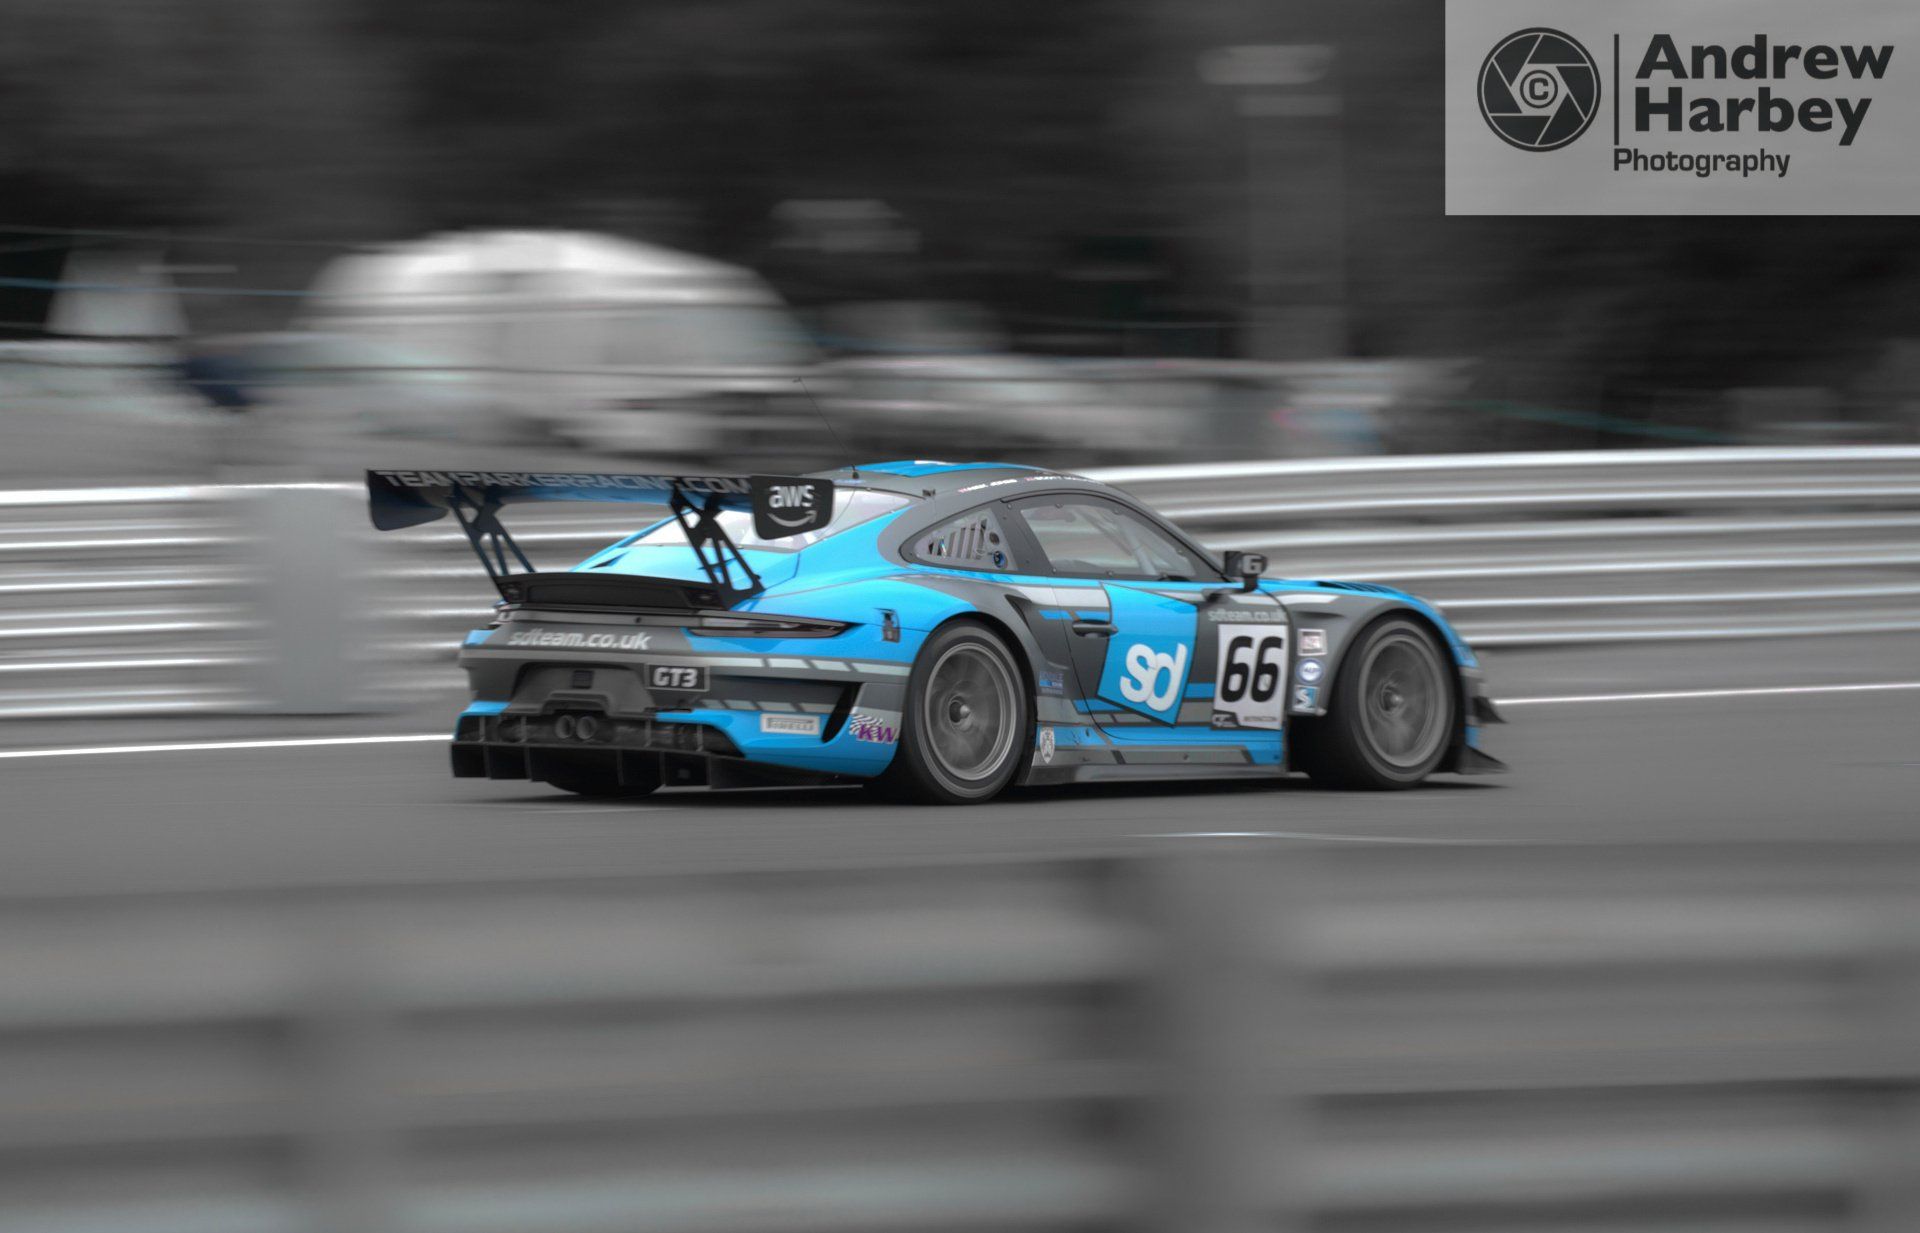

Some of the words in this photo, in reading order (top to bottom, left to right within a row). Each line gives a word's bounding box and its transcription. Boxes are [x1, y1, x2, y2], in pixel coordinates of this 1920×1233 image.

[768, 484, 816, 508] aws
[507, 628, 652, 650] sdteam.co.uk
[652, 666, 699, 688] GT3
[1221, 635, 1283, 703] 66
[857, 724, 898, 743] KW
